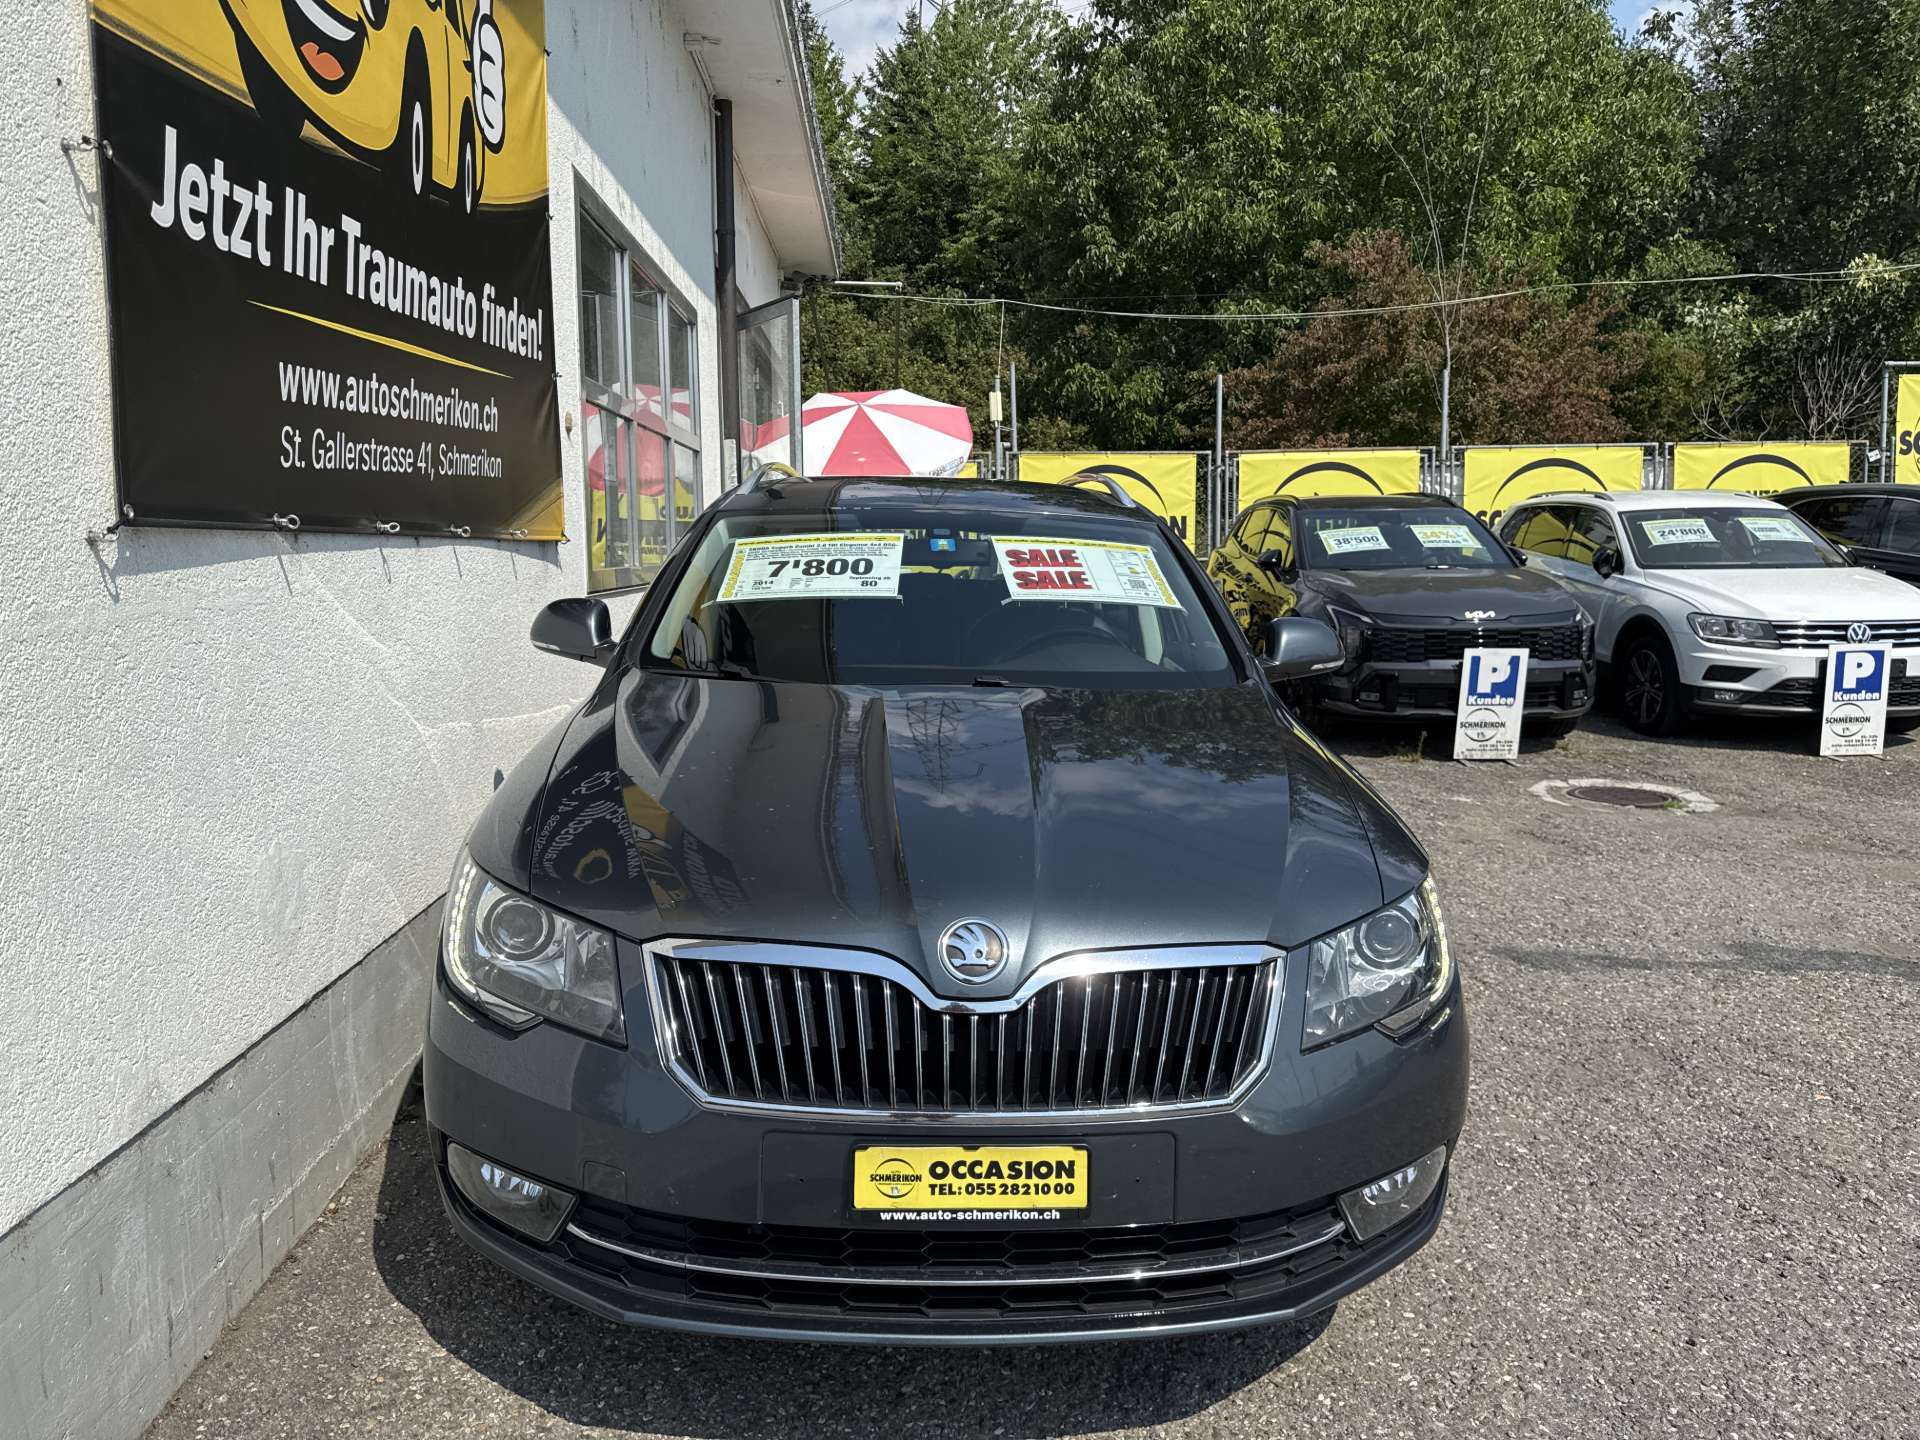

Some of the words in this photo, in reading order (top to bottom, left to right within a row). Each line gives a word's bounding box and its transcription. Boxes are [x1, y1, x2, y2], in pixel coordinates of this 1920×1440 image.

[151, 125, 272, 268] Jetzt
[284, 187, 335, 285] Ihr
[341, 214, 477, 340] Traumauto
[481, 282, 543, 361] finden!
[279, 361, 499, 434] www.autoschmerikon.ch
[280, 426, 306, 470] St.
[312, 428, 414, 475] Gallerstrasse
[417, 449, 435, 481] 41,
[438, 448, 502, 479] Schmerikon
[1333, 535, 1379, 546] 38'500
[767, 558, 874, 578] 7'800
[1005, 548, 1083, 568] SALE
[1012, 570, 1093, 590] SALE
[1476, 655, 1512, 694] P
[1842, 652, 1876, 690] P
[1468, 695, 1515, 707] Kunden
[1833, 690, 1880, 701] Kunden
[1459, 720, 1506, 729] SCHMERIKON
[1825, 715, 1871, 724] SCHMERIKON
[870, 1173, 922, 1182] SCHMERIKON
[928, 1159, 1076, 1180] OCCASION
[928, 1183, 963, 1196] TEL:
[879, 1209, 1061, 1221] www.auto-schmerikon.ch
